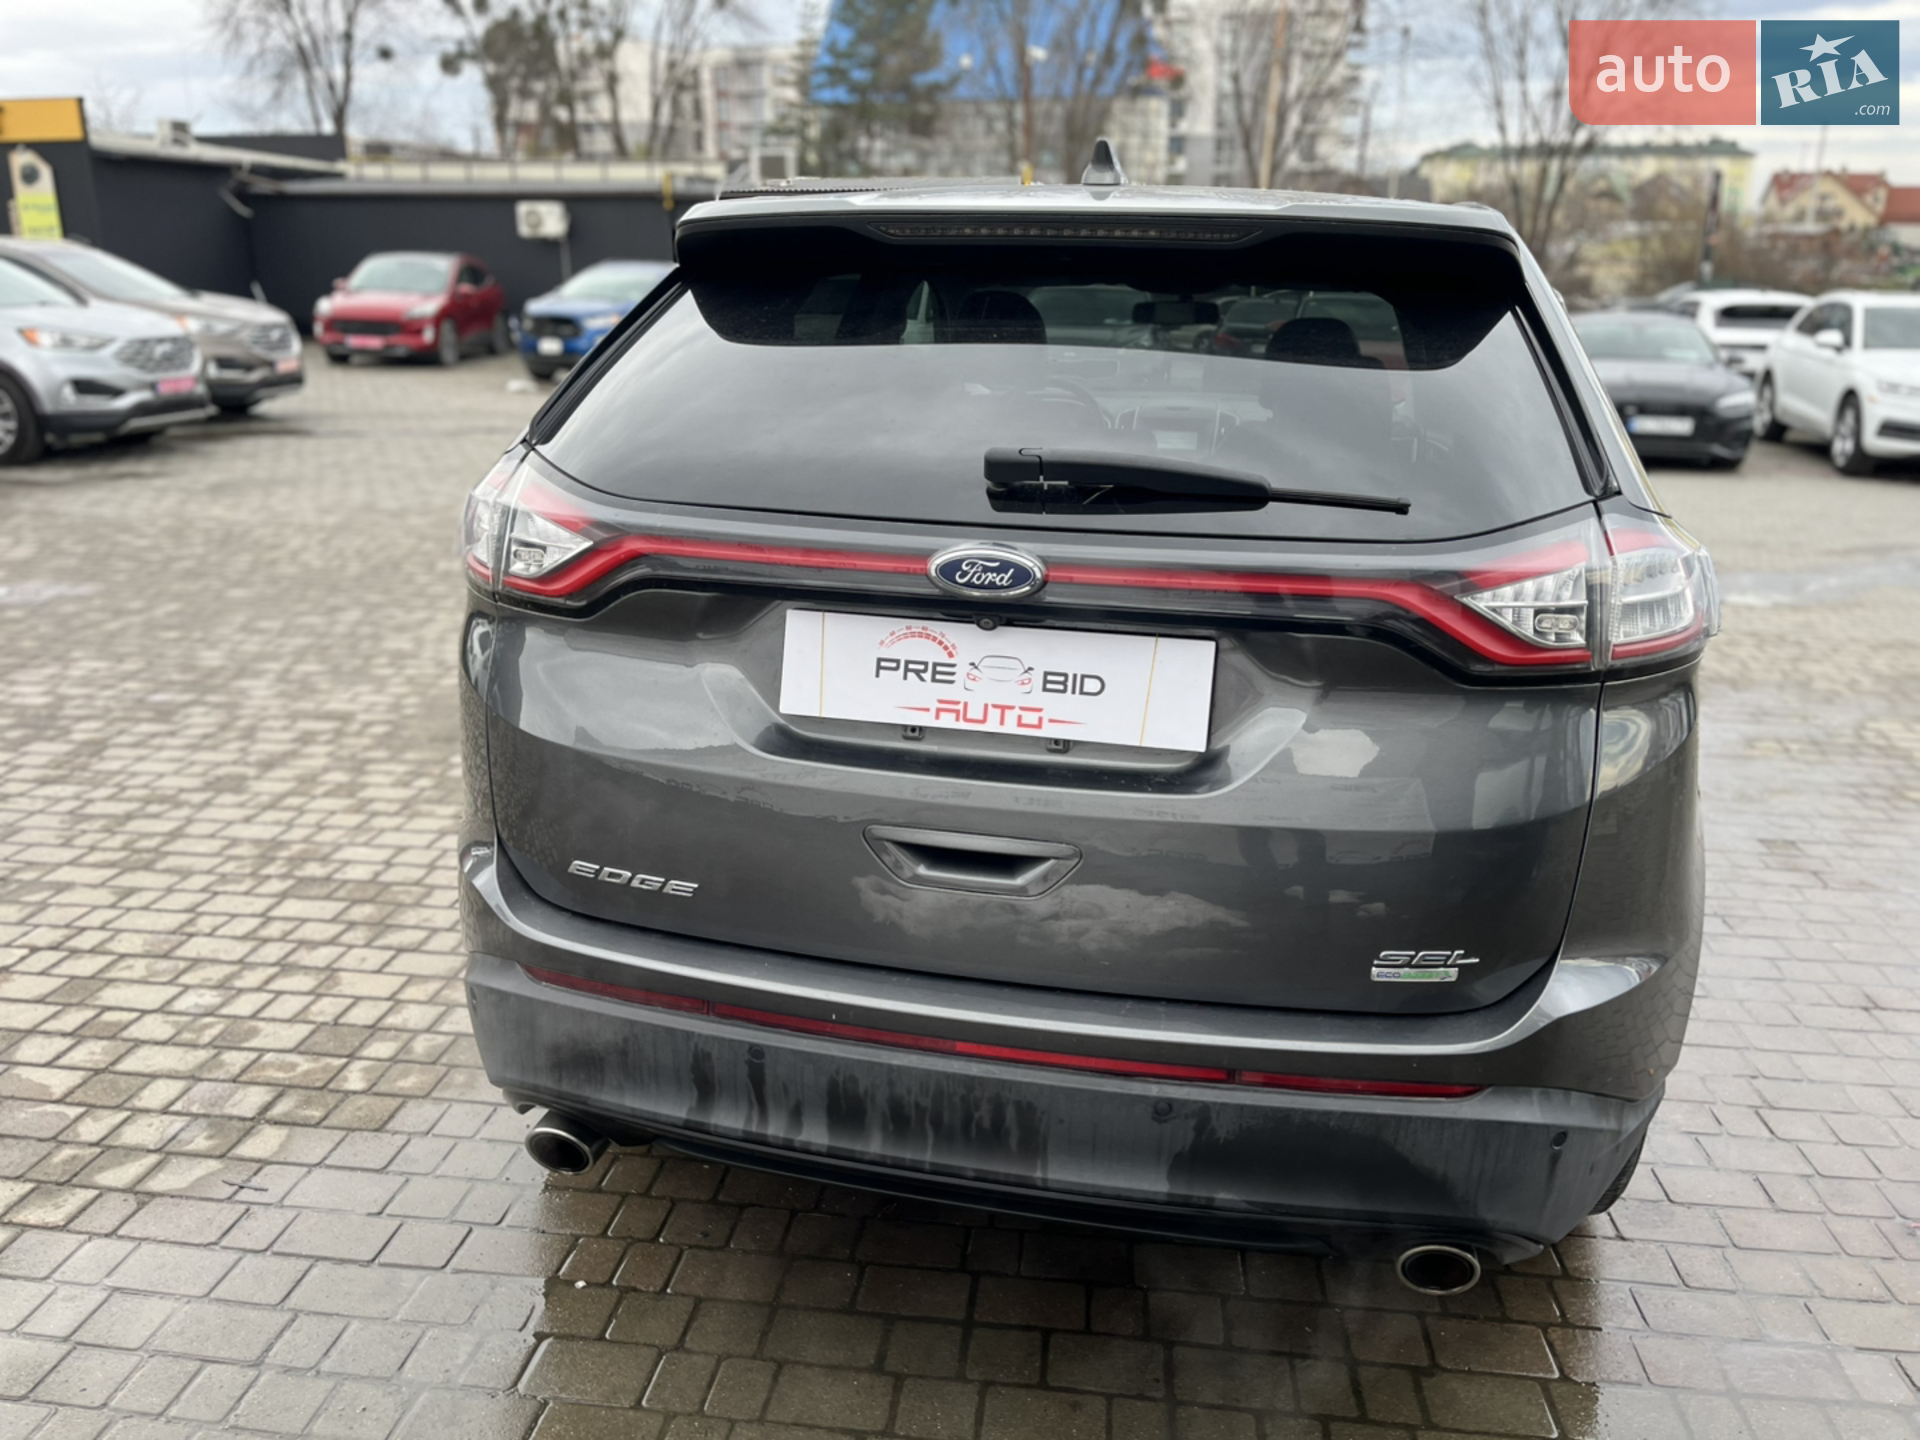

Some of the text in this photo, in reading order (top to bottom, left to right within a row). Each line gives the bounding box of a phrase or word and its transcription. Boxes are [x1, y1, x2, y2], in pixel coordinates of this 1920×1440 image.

[955, 559, 1015, 587] Ford
[875, 656, 1106, 697] PRE BID
[934, 698, 1044, 729] AUTO
[567, 860, 699, 897] EDGE
[1373, 949, 1480, 965] SEL
